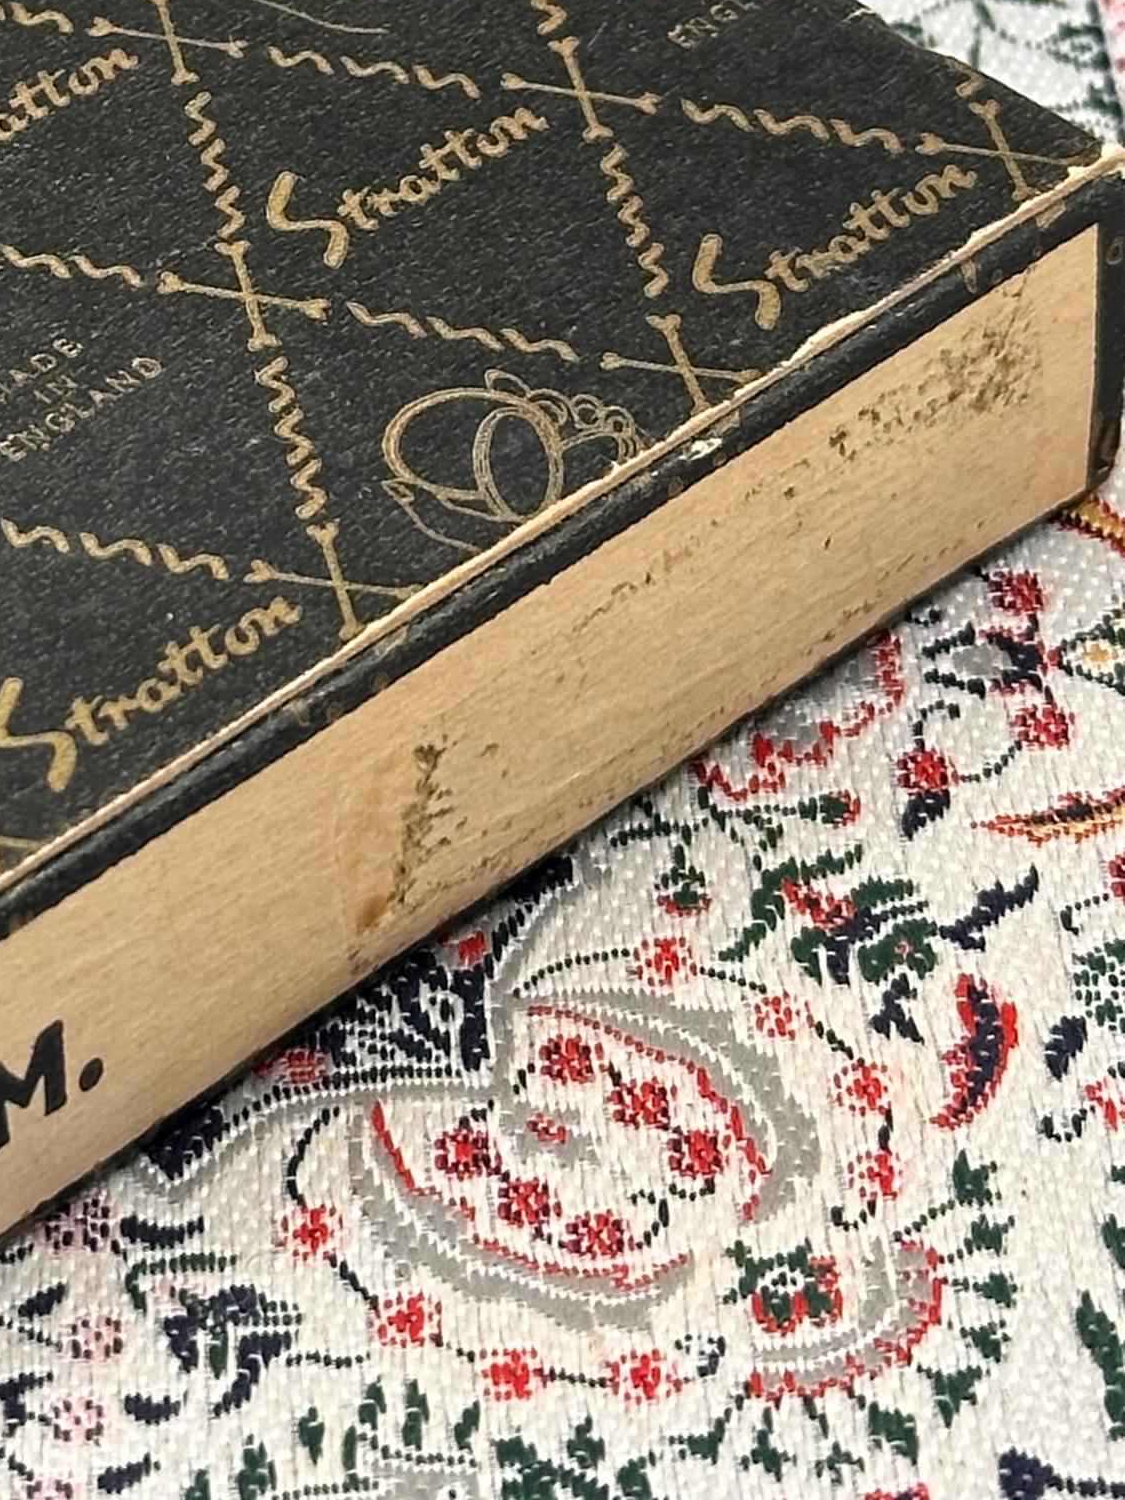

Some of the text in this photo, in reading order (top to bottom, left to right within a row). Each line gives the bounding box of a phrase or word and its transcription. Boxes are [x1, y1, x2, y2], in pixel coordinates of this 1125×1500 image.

[265, 106, 548, 270] Stratton
[691, 164, 978, 331] Stratton
[33, 373, 78, 404] IN
